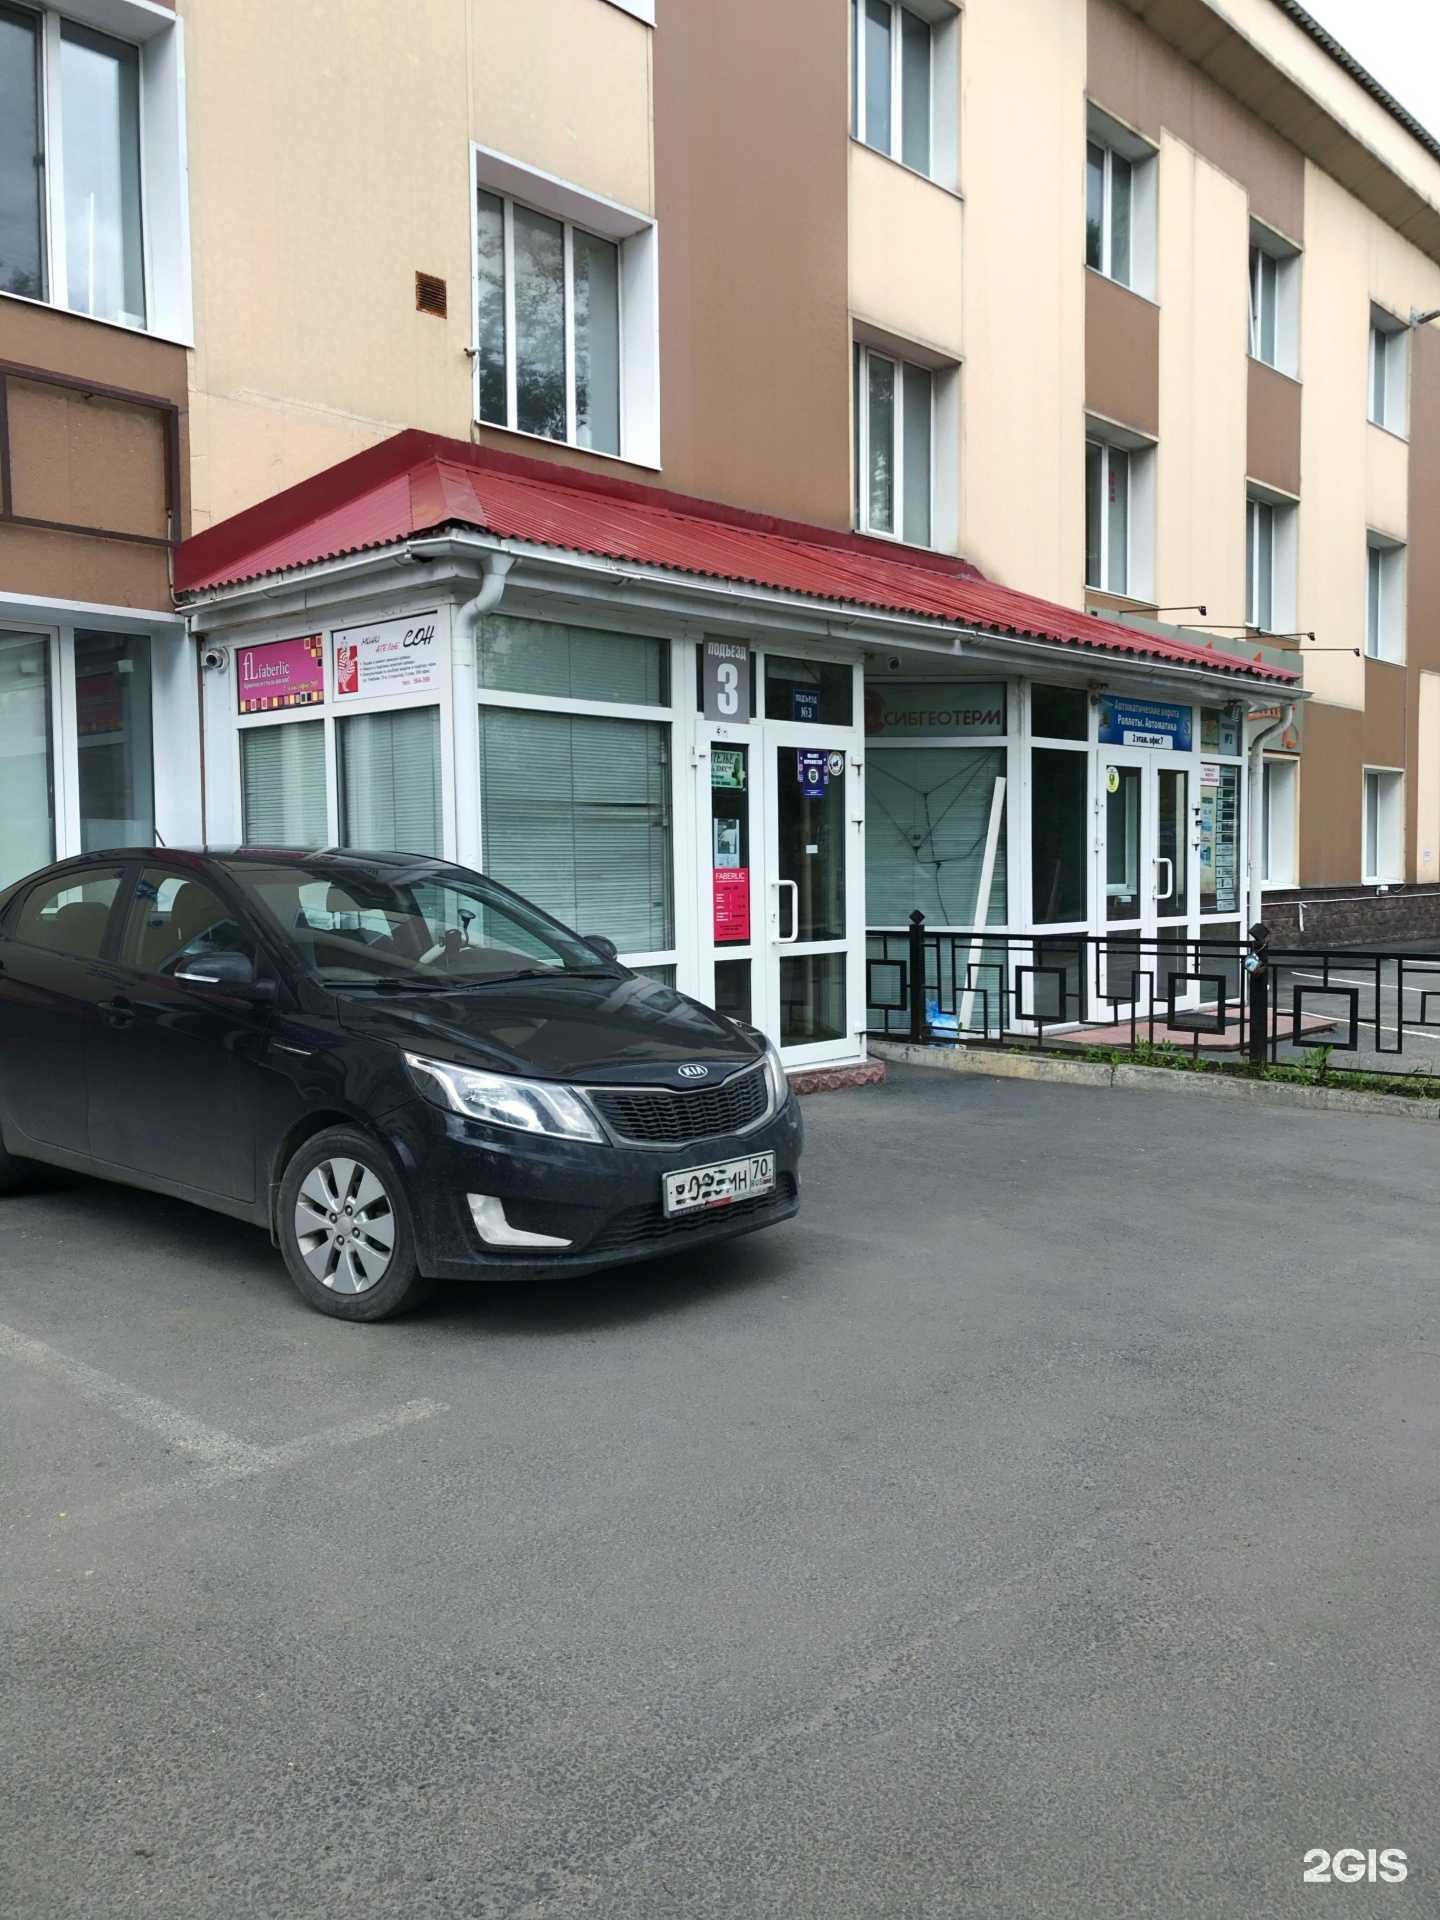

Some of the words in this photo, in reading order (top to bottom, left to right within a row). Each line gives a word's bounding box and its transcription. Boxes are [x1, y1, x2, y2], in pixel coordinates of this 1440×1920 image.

[707, 642, 746, 661] ПОДЪЕЗД
[717, 662, 738, 715] 3
[884, 709, 1001, 726] СИБГЕОТЕРМ
[1145, 717, 1177, 731] Автоматика
[715, 872, 745, 880] FABERLIC
[685, 1065, 704, 1076] KIA
[752, 1157, 768, 1179] 70
